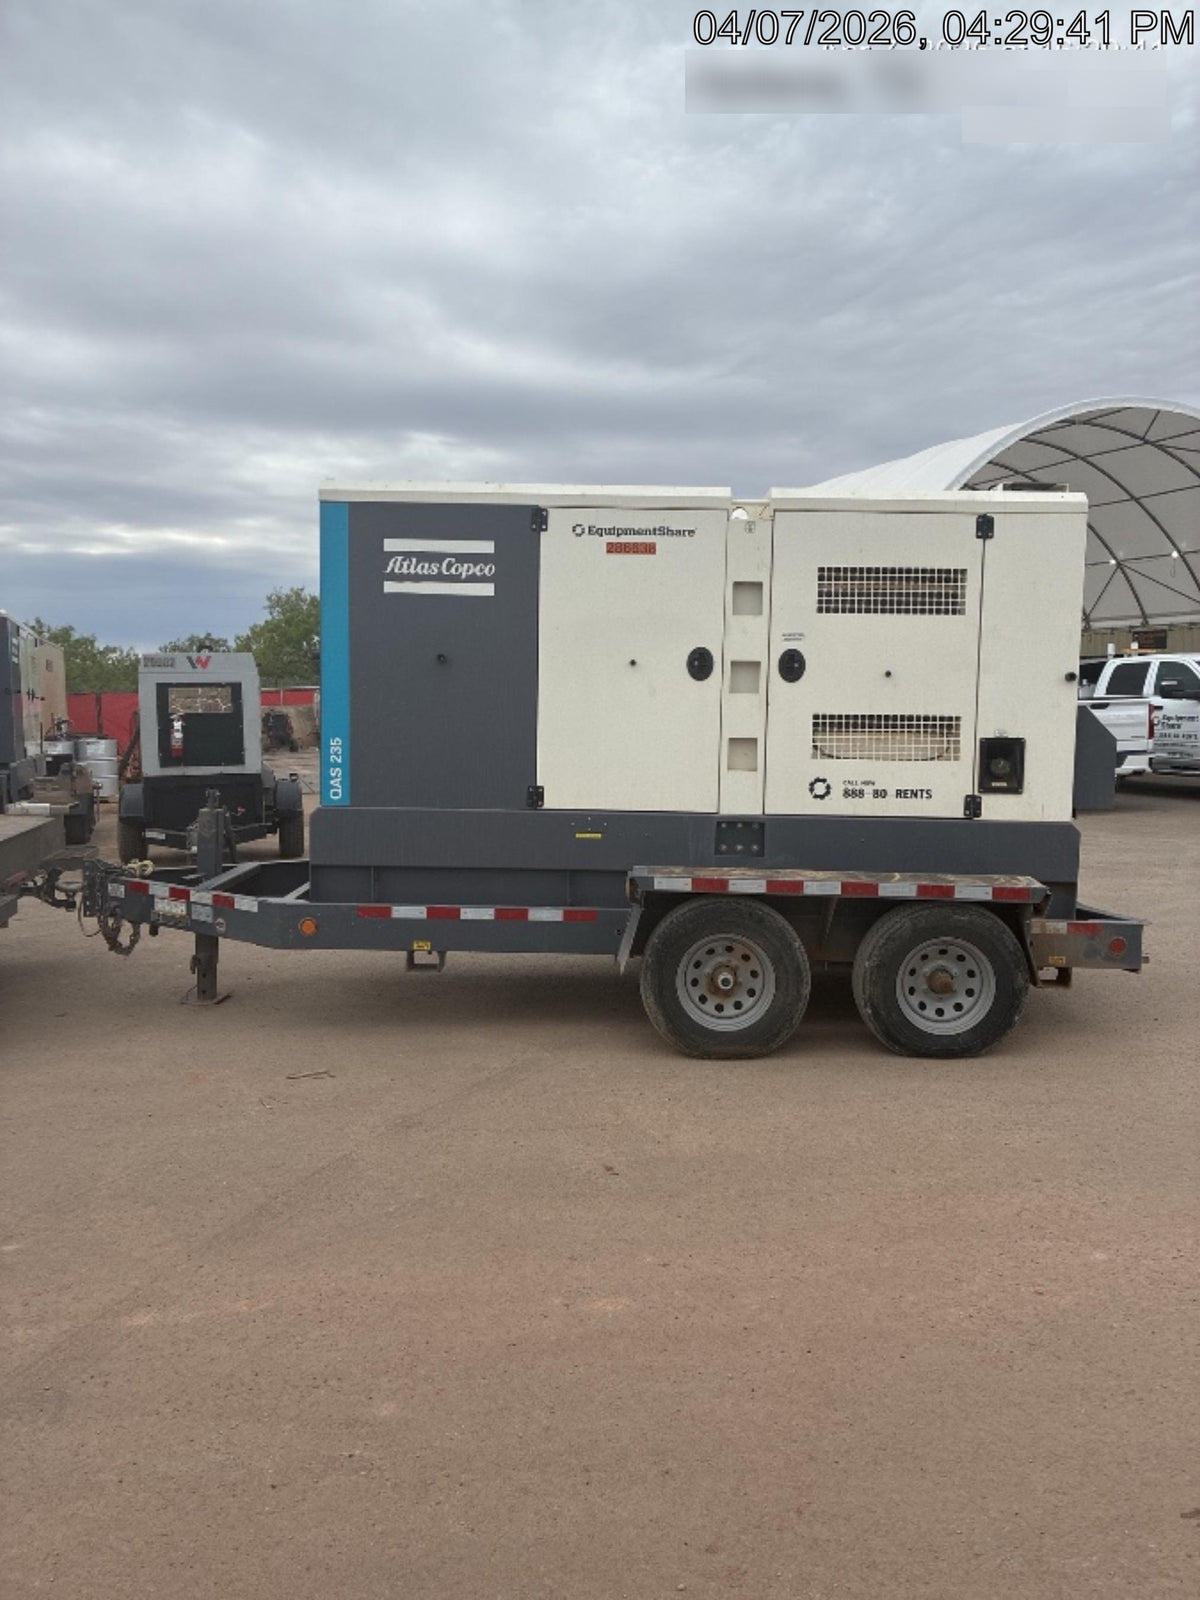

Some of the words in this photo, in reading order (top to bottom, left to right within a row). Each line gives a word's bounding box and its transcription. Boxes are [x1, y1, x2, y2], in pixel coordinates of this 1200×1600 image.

[587, 525, 696, 538] EquipmentShare
[382, 556, 440, 575] Atlas
[441, 557, 496, 579] Copco
[329, 737, 343, 764] 235
[329, 767, 343, 800] QAS
